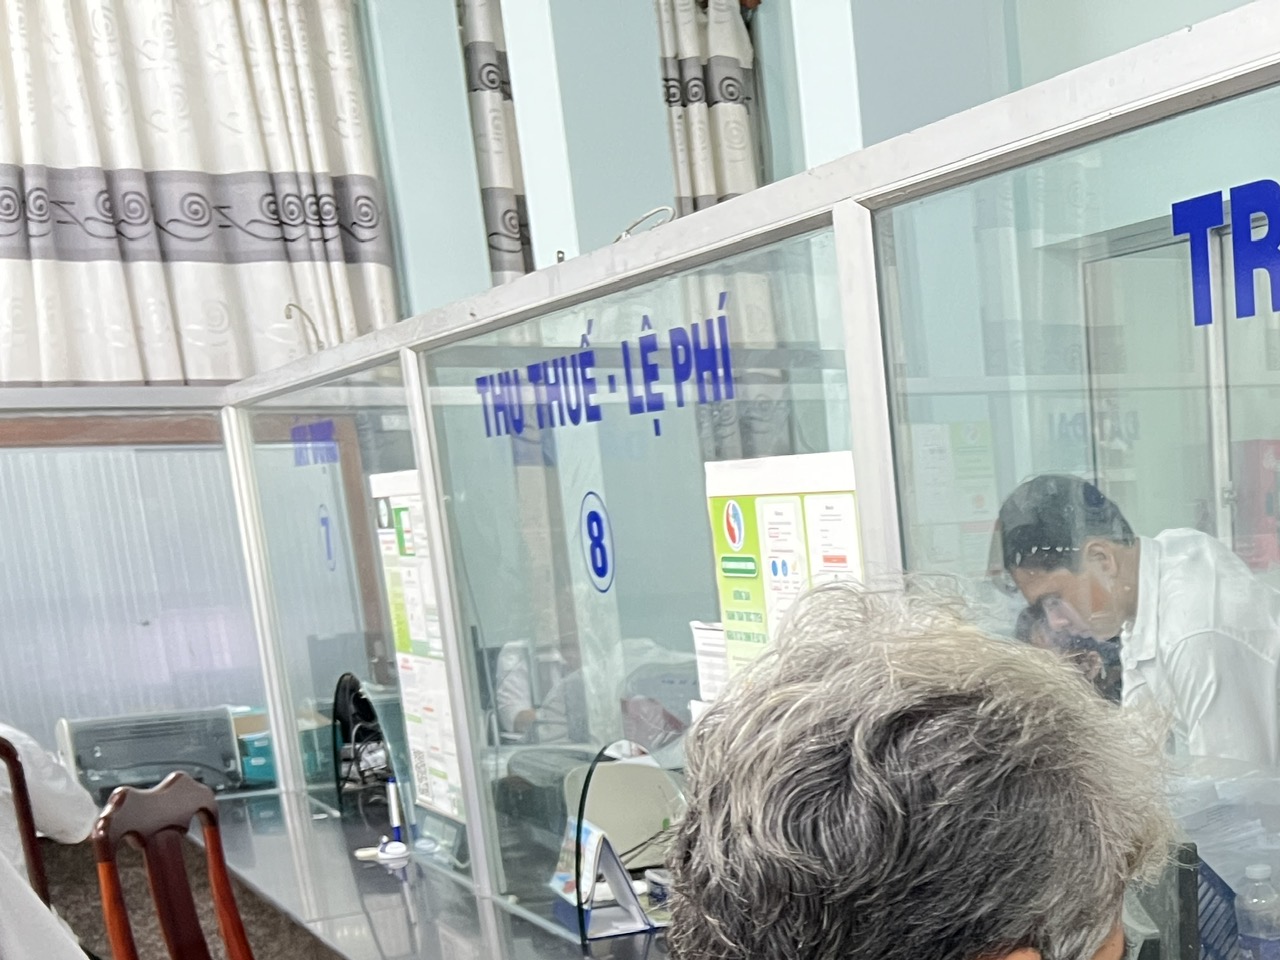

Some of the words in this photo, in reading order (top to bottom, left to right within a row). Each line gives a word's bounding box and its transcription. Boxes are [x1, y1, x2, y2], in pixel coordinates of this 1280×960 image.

[475, 369, 525, 438] THU
[527, 319, 602, 430] THUẾ
[621, 315, 665, 436] LỆ
[669, 291, 735, 408] PHÍ
[585, 511, 608, 578] 8
